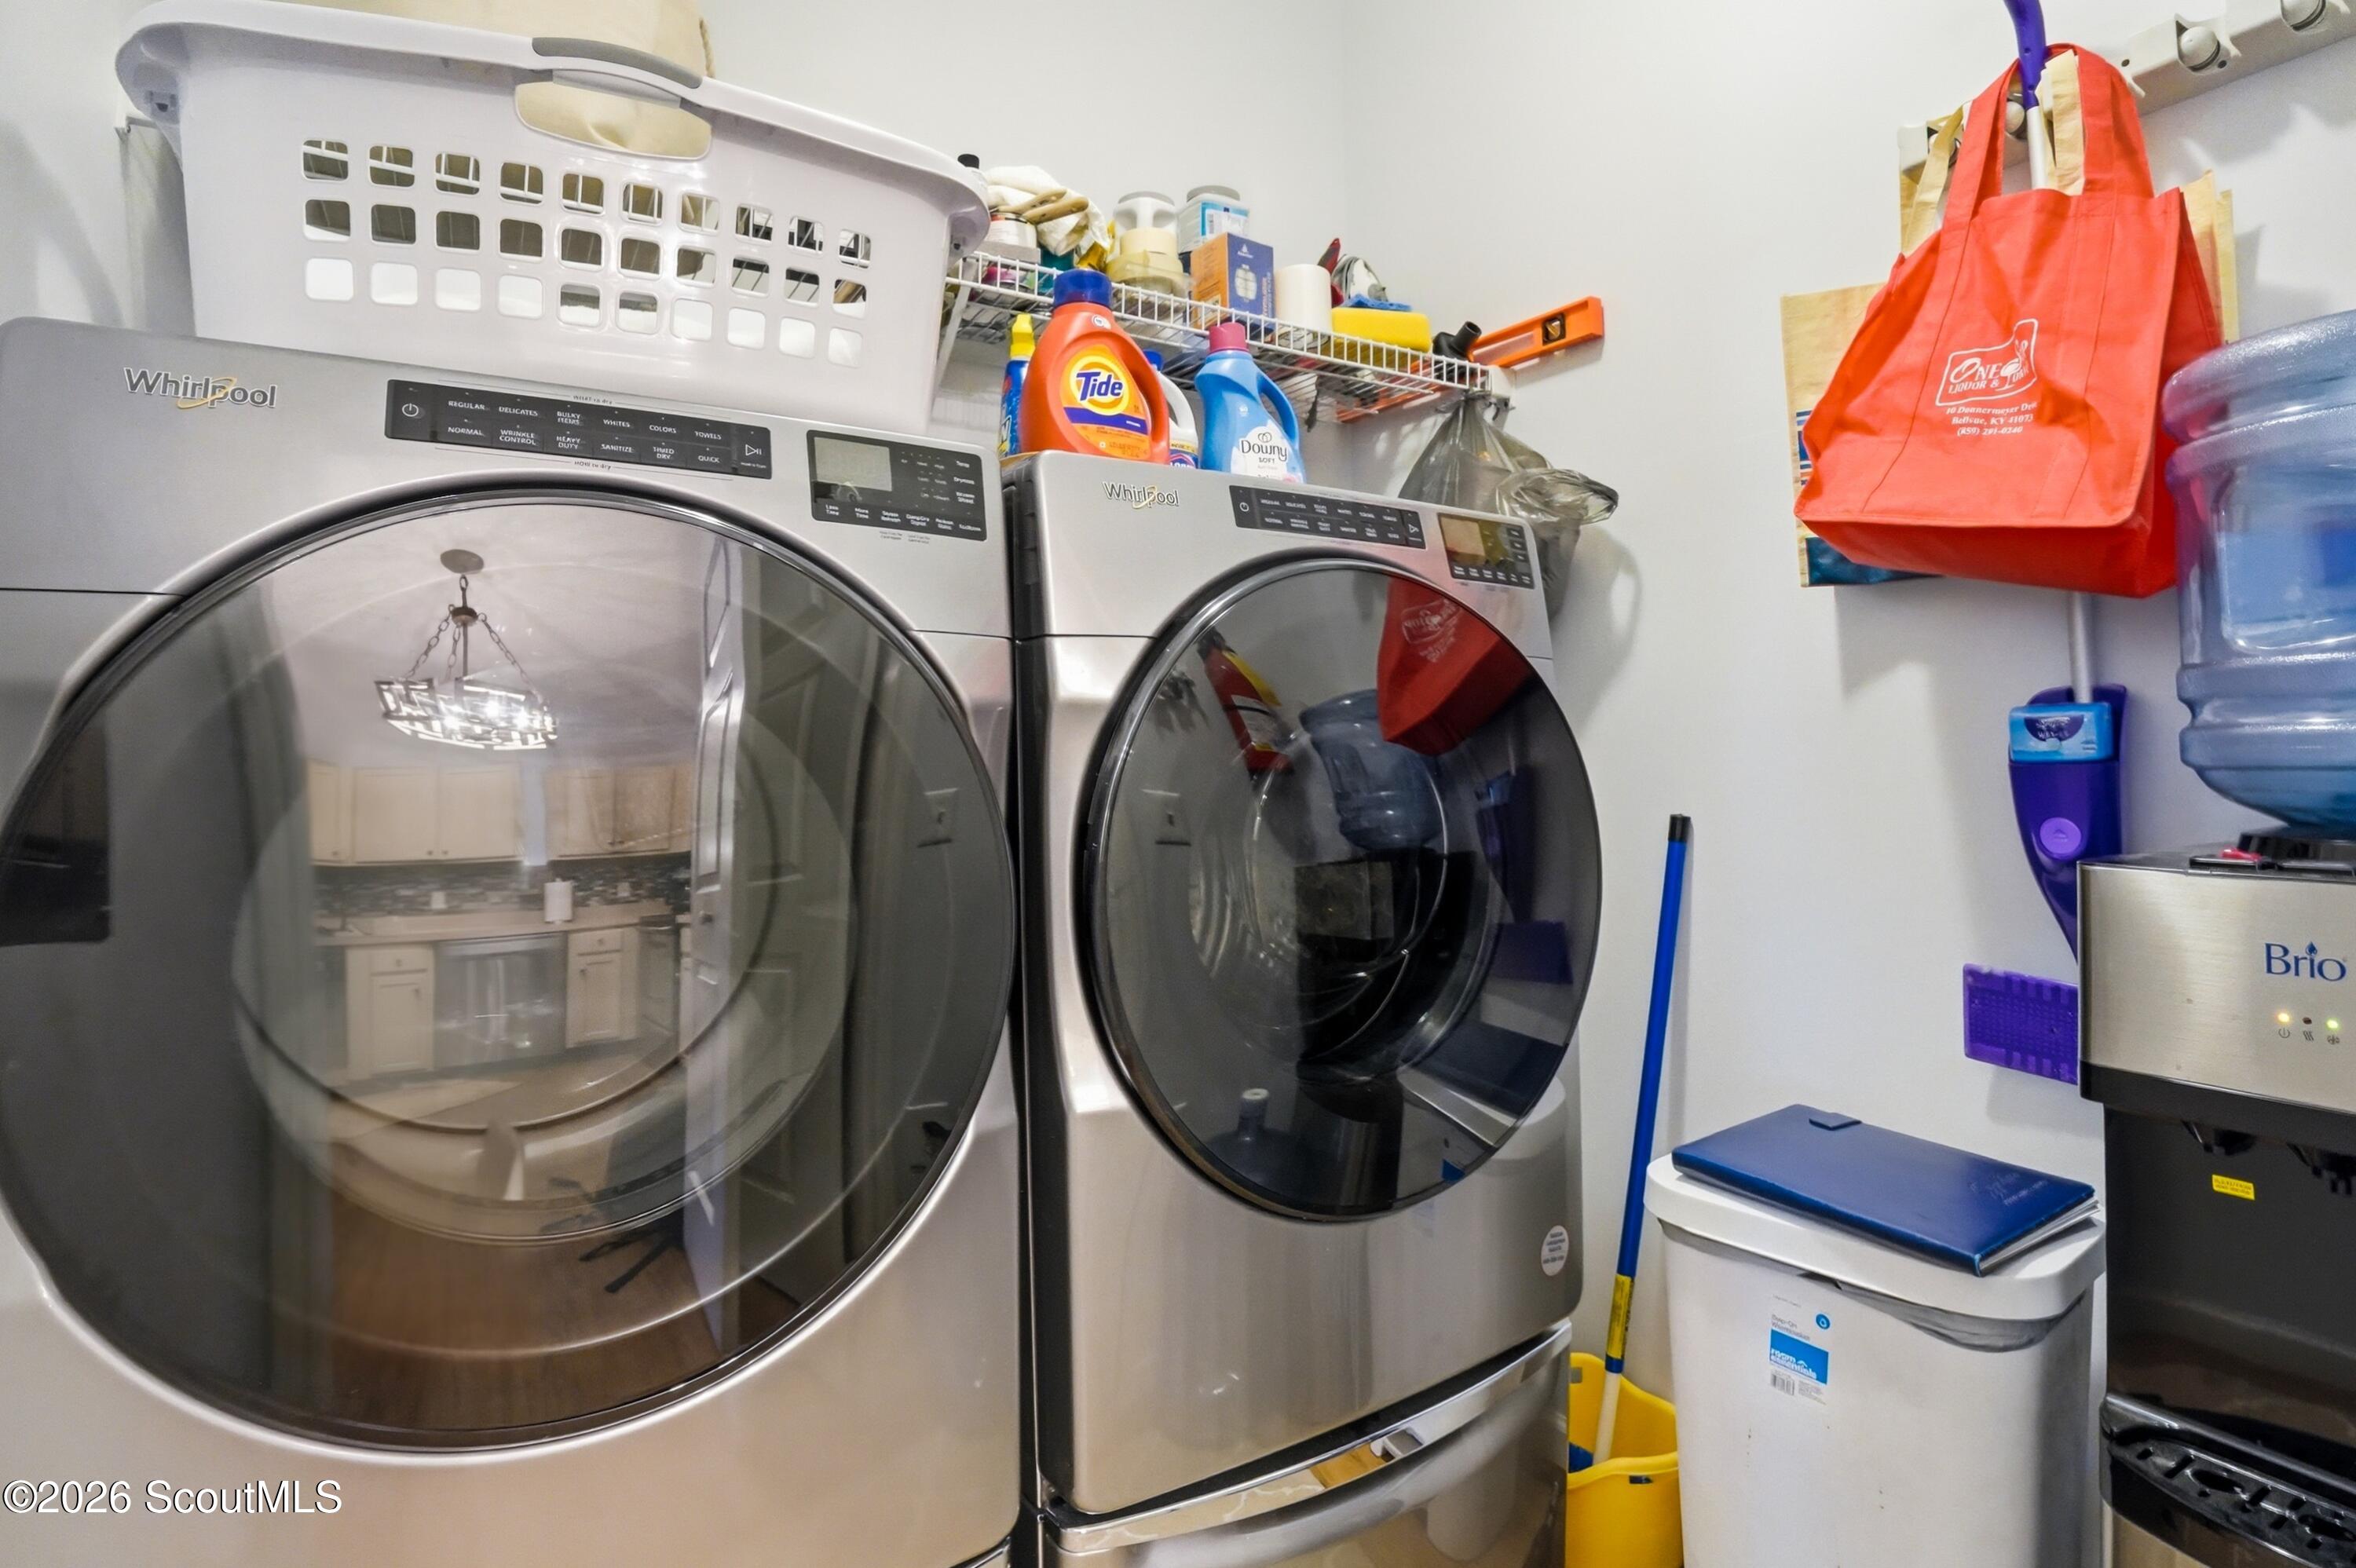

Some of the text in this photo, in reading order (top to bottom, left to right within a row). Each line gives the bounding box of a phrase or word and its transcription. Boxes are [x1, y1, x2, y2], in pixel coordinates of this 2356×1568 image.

[123, 367, 278, 409] Whirlpool
[1076, 371, 1124, 402] Tide
[1948, 379, 1999, 393] LIQUOR &
[448, 400, 486, 411] REGULAR
[498, 405, 539, 417] DELICATES
[556, 411, 581, 419] BULKY
[602, 418, 631, 428] WHITES
[447, 426, 485, 437] NORMAL
[499, 429, 536, 439] WRINKLE
[649, 424, 677, 434] COLORS
[499, 435, 537, 445] CONTROL
[694, 430, 722, 440] TOWELS
[601, 443, 633, 453] SANITIZE
[1240, 439, 1287, 462] Downy
[697, 455, 721, 464] QUICK
[1102, 481, 1180, 510] Whirlpool
[2264, 941, 2347, 981] Brio
